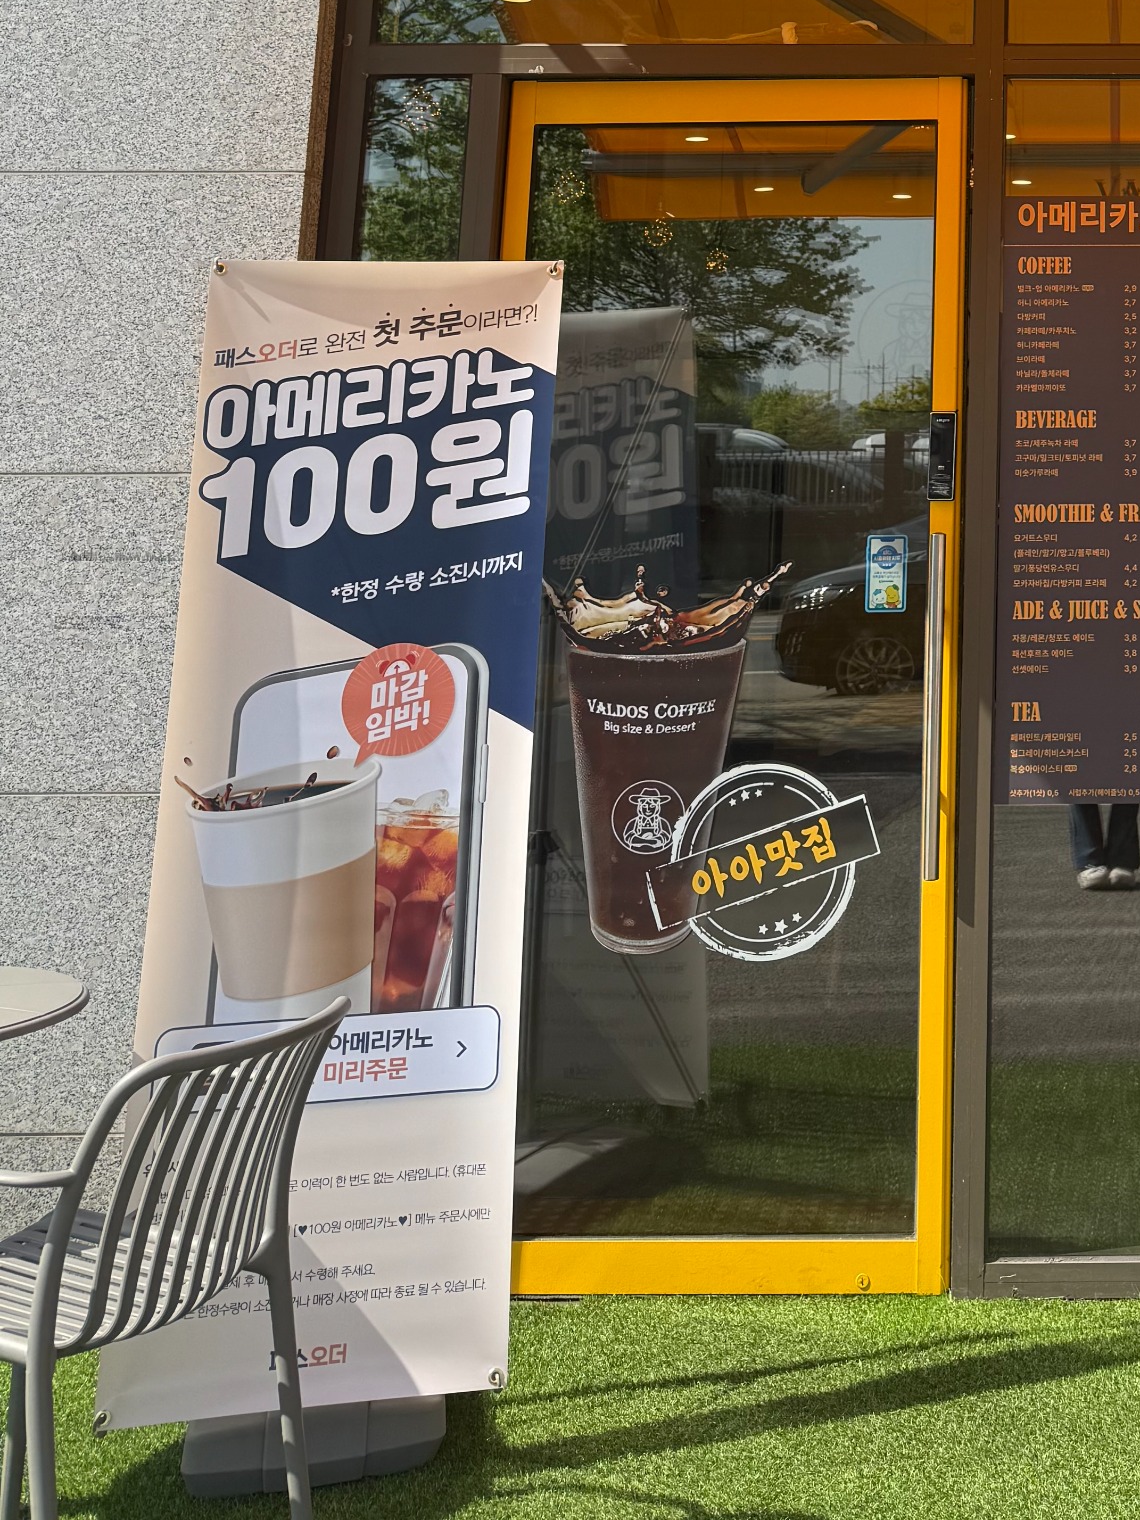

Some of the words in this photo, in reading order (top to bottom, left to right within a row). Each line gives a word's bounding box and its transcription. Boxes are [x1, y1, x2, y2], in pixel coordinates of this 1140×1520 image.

[1017, 256, 1072, 275] COFFEE
[214, 337, 318, 368] 패스오더로
[324, 330, 366, 354] 완전
[372, 318, 400, 348] 첫
[408, 304, 538, 341] 주문이라면?!
[207, 350, 534, 449] 아메리카노
[1015, 409, 1097, 429] BEVERAGE
[202, 410, 533, 559] 100원
[1013, 503, 1095, 523] SMOOTHIE
[1099, 504, 1114, 522] &
[385, 572, 425, 595] 수량
[429, 551, 524, 586] 소진시까지
[1012, 600, 1044, 620] ADE
[1049, 601, 1063, 620] &
[1068, 599, 1109, 622] JUICE
[1113, 600, 1128, 620] &
[370, 669, 429, 710] 마감
[365, 700, 430, 743] 임박!
[587, 698, 649, 719] VALDOS
[654, 699, 716, 719] COFFEE
[1011, 702, 1041, 722] TEA
[604, 720, 619, 734] Big
[622, 723, 643, 734] size
[644, 724, 654, 734] &
[656, 721, 697, 734] Dessert
[691, 817, 837, 898] 아아맛집
[327, 1027, 434, 1055] 아메리카노
[323, 1056, 408, 1084] 미리주문
[301, 1176, 333, 1191] 이력이
[336, 1175, 346, 1188] 한
[349, 1173, 370, 1187] 번도
[373, 1172, 394, 1185] 없는
[452, 1163, 486, 1178] (휴대폰
[415, 1213, 436, 1225] 메뉴
[439, 1208, 491, 1223] 주문시에만
[244, 1275, 255, 1286] 후
[305, 1267, 338, 1282] 수령해
[312, 1293, 333, 1306] 매장
[336, 1289, 368, 1304] 사정에
[370, 1287, 392, 1300] 따라
[394, 1284, 415, 1298] 종료
[431, 1282, 441, 1295] 수
